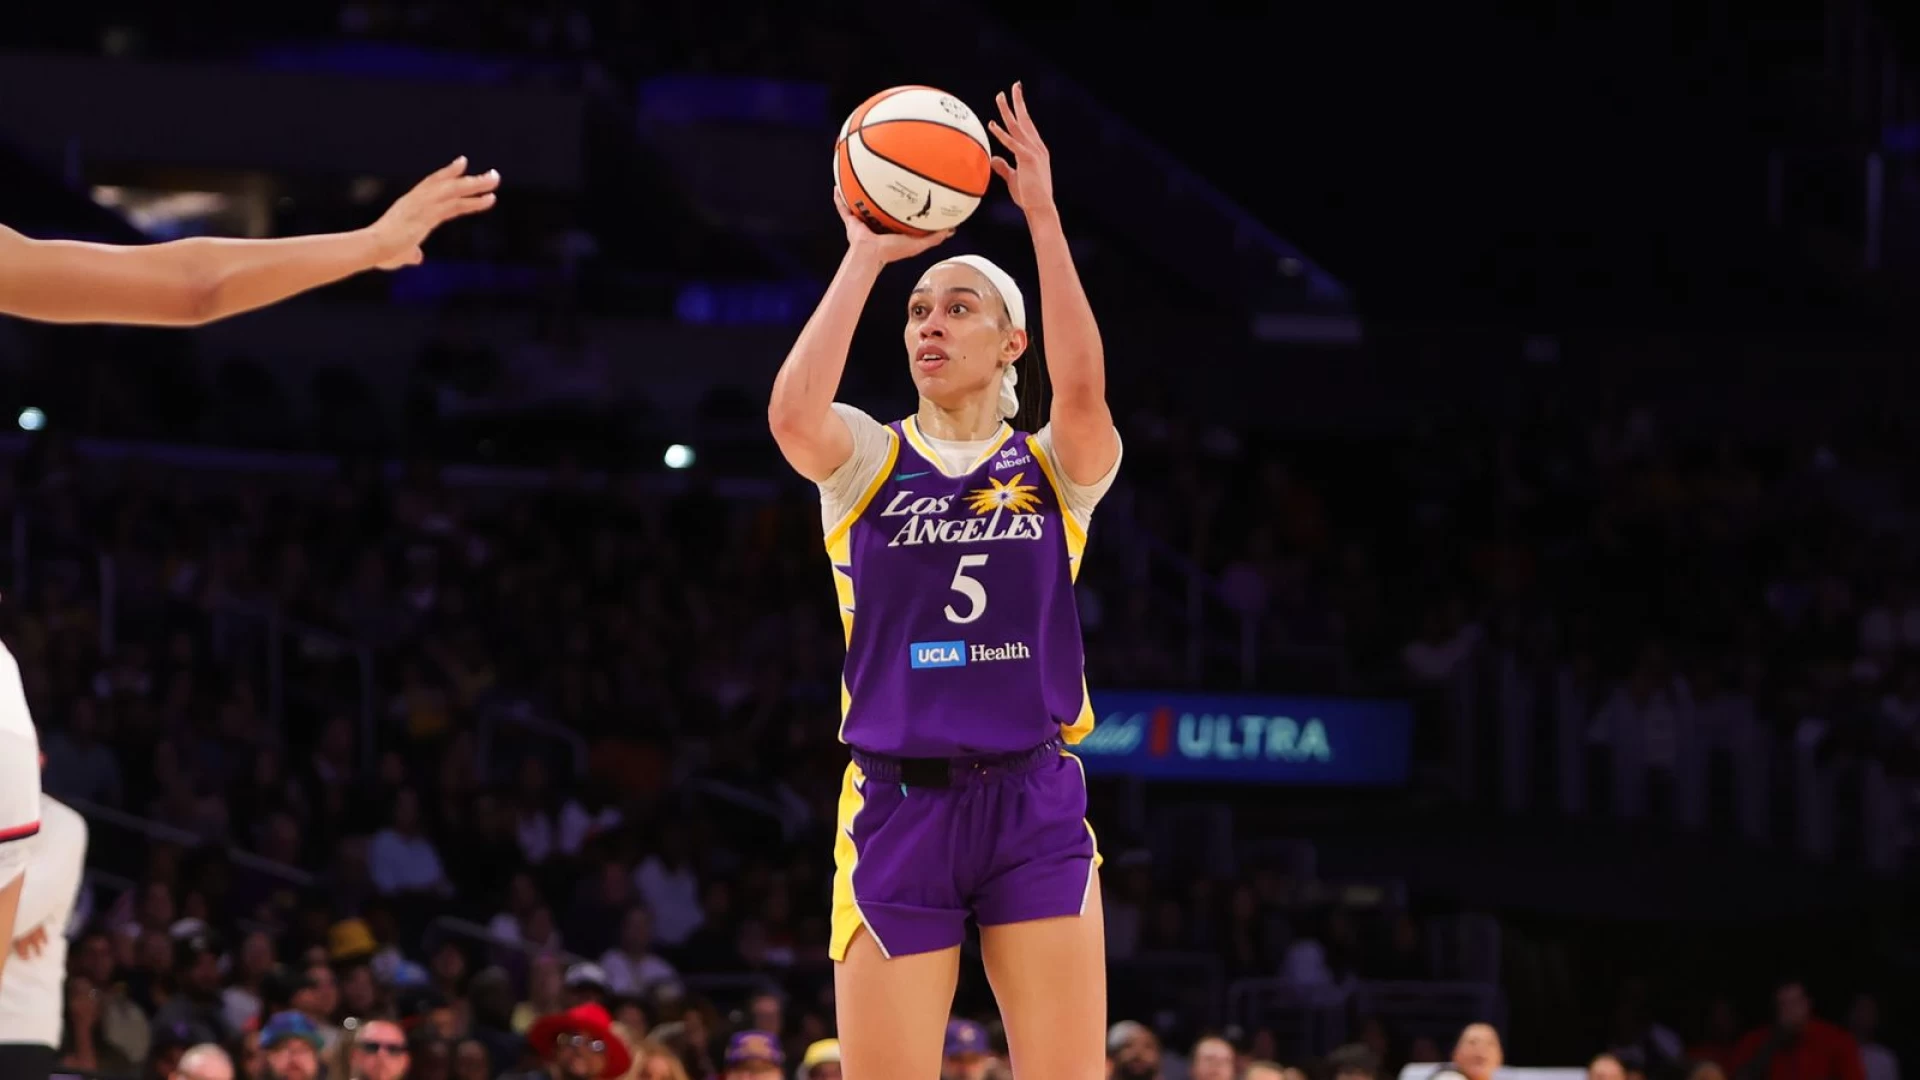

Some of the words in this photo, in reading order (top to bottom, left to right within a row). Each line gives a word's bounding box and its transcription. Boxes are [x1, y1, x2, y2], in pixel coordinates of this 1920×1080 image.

[995, 455, 1031, 471] Albert
[880, 491, 955, 517] Los
[888, 505, 1045, 547] ANGELES
[944, 554, 989, 624] 5
[918, 647, 960, 663] UCLA
[970, 642, 1031, 662] Health
[1177, 712, 1333, 763] ULTRA
